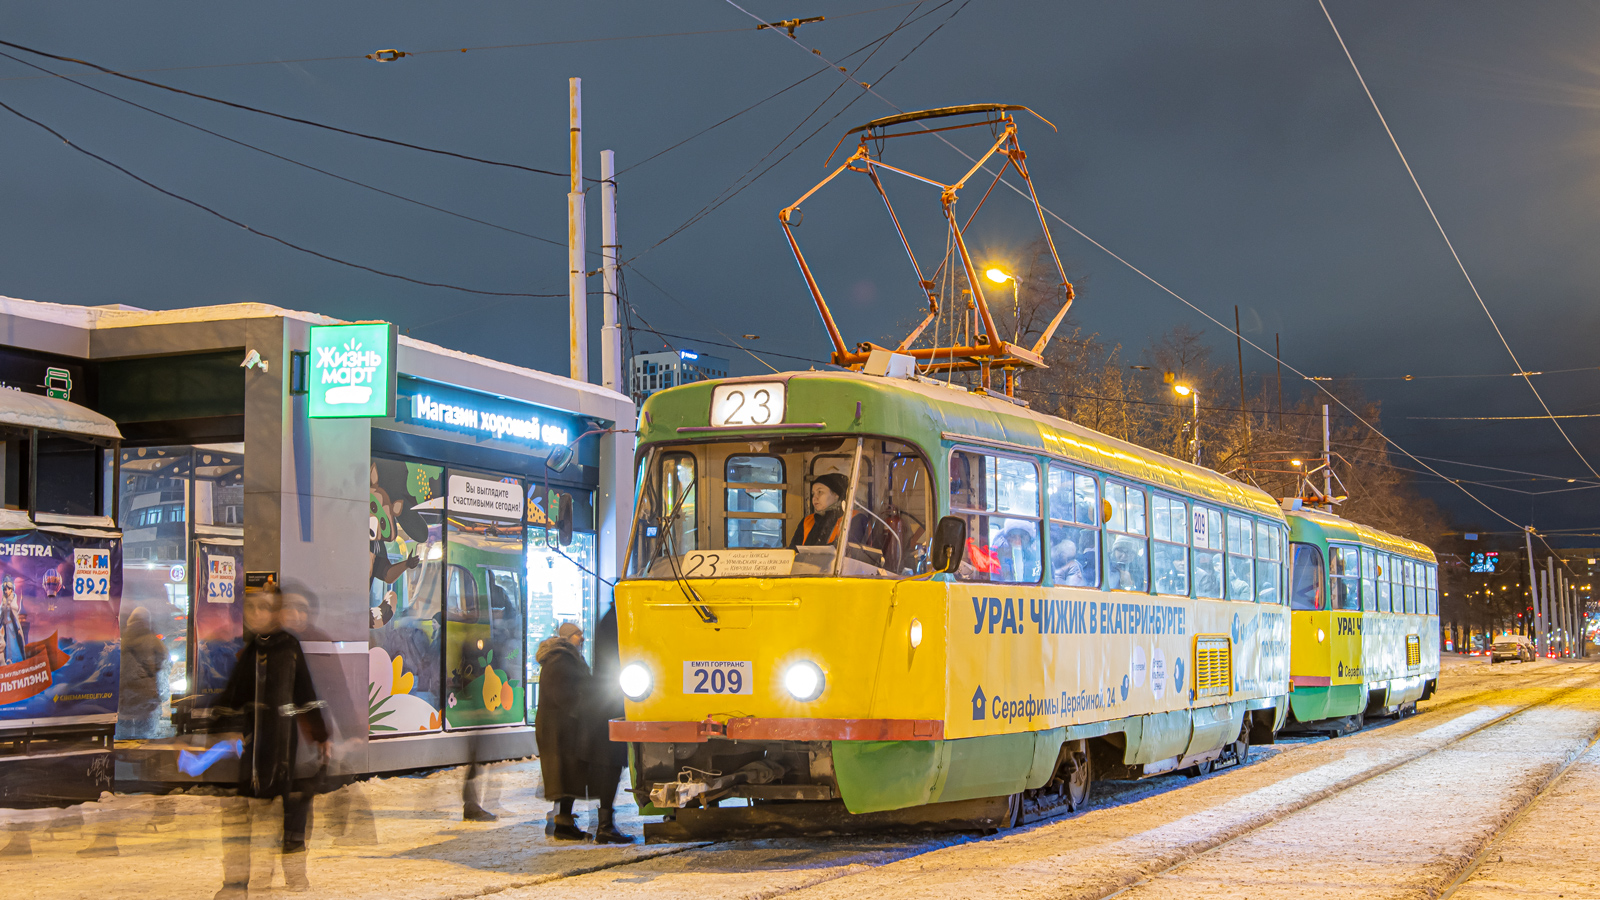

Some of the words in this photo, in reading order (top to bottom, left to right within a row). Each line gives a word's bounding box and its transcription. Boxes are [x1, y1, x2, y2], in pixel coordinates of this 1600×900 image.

[316, 346, 382, 368] Жизнь
[321, 367, 376, 386] март
[416, 394, 479, 429] Магазин
[480, 411, 540, 441] хорошей
[723, 388, 771, 425] 23
[465, 481, 476, 493] Вы
[476, 486, 509, 499] выглядите
[452, 495, 494, 509] счастливыми
[495, 501, 521, 513] сегодня!
[1194, 512, 1206, 535] 209
[684, 554, 720, 577] 23
[75, 577, 108, 595] 89.2
[971, 596, 1024, 635] УРА!
[1030, 598, 1087, 635] ЧИЖИК
[1089, 601, 1098, 635] В
[1100, 602, 1186, 635] ЕКАТЕРИНБУРГЕ!
[1337, 616, 1356, 636] УРА!
[1, 670, 49, 693] ЛЬТИЛЭНД
[693, 668, 743, 694] 209
[992, 693, 1059, 724] Серафимы
[1060, 689, 1106, 718] Дерябиной,
[1106, 686, 1116, 708] 24
